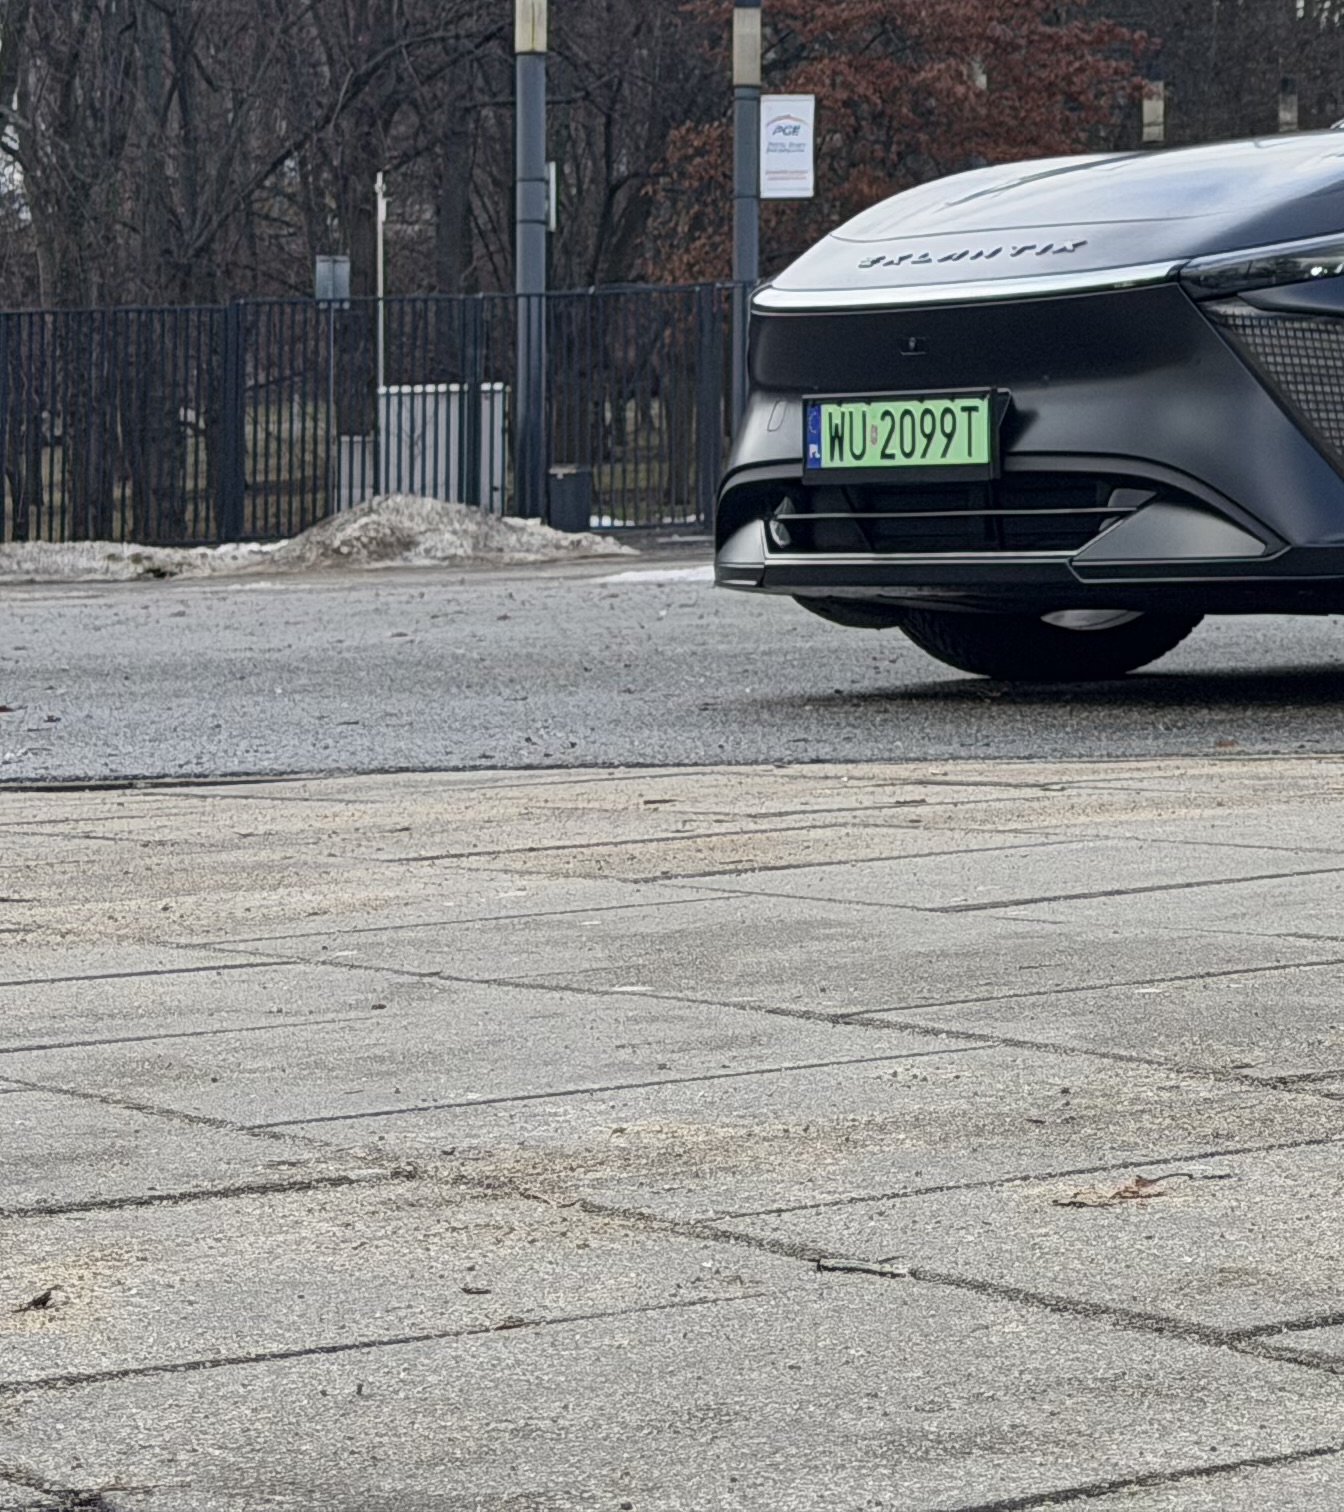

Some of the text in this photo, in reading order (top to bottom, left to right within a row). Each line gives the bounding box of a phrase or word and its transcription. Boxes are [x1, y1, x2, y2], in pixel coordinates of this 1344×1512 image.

[772, 124, 801, 137] PGE
[828, 405, 979, 463] WU 2099T
